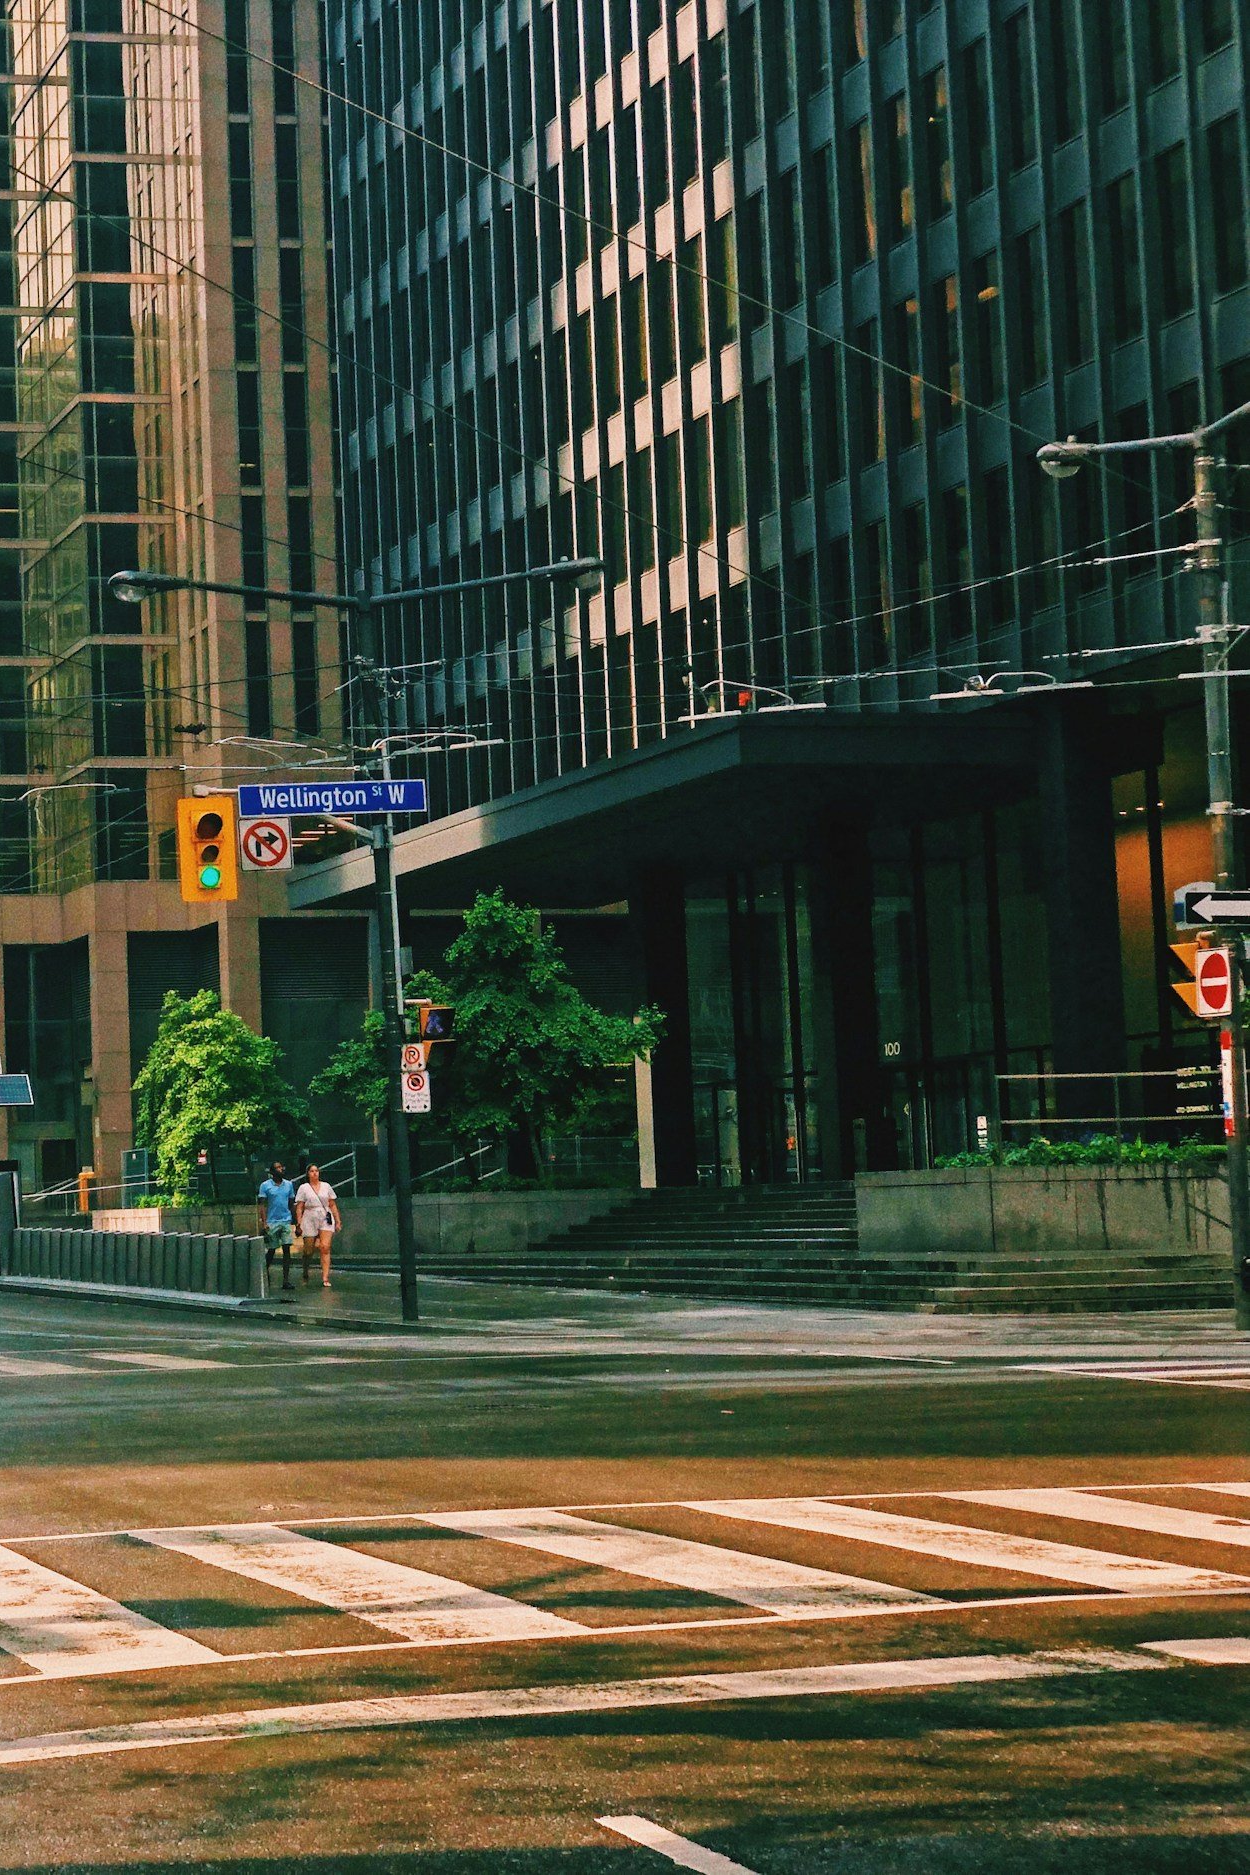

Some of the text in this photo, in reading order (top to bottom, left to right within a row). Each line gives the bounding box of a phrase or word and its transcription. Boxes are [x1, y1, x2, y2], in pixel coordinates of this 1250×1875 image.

[258, 784, 405, 812] Wellington St W
[884, 1041, 901, 1057] 100
